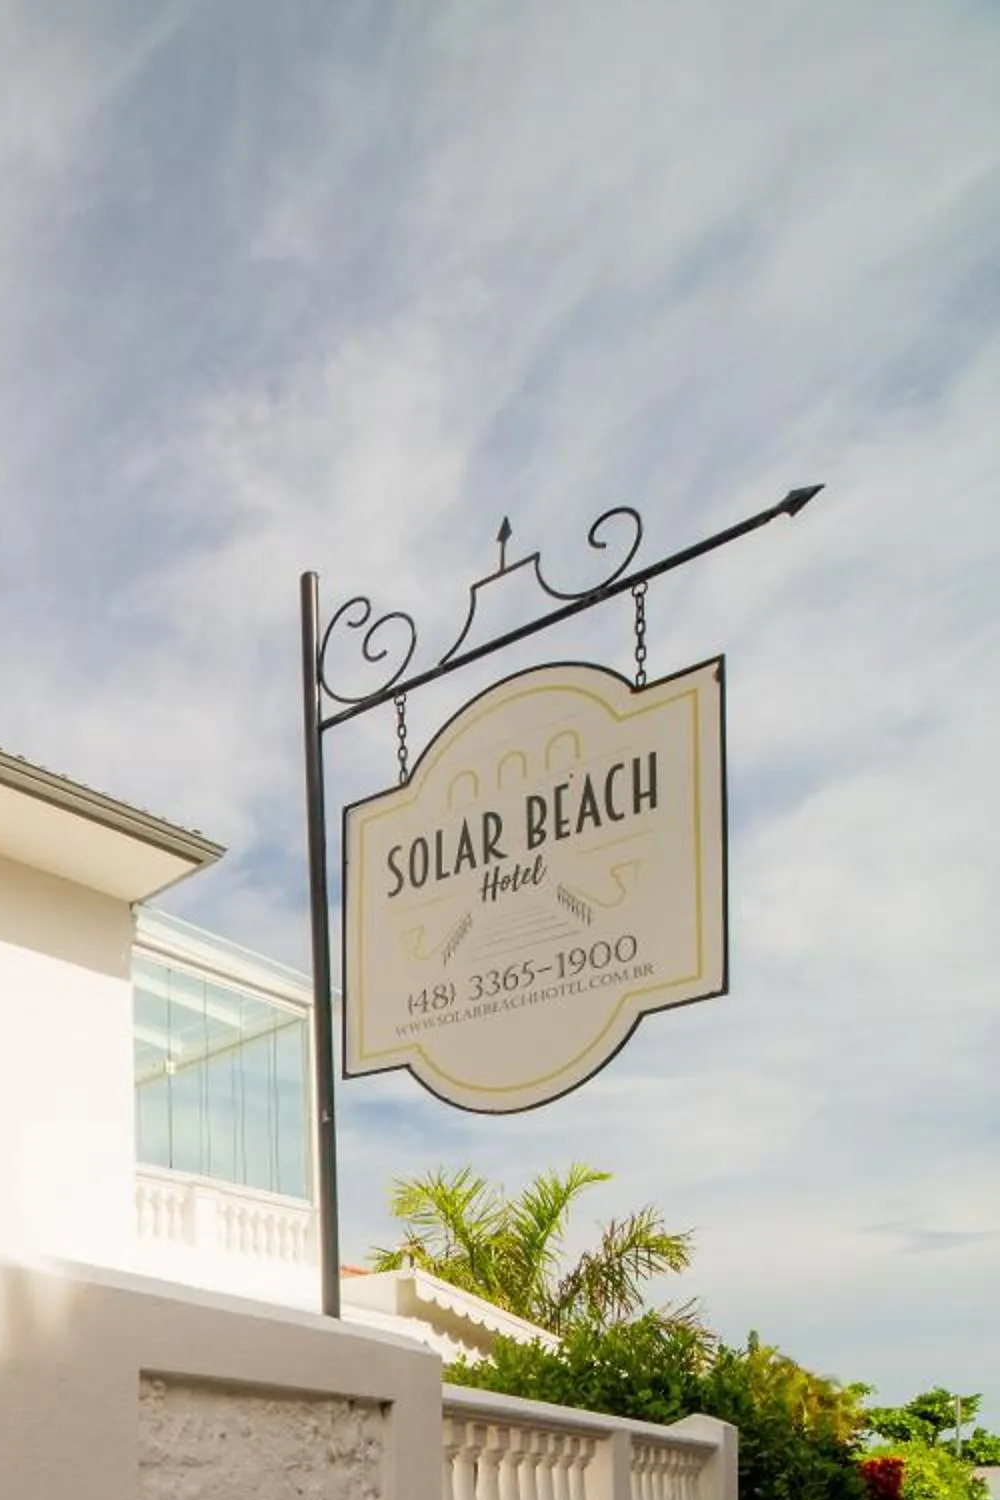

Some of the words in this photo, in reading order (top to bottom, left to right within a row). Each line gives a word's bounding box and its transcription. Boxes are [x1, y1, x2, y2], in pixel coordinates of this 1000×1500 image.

[386, 811, 507, 897] SOLAR
[526, 751, 658, 850] BEACH
[479, 854, 548, 903] Hotel
[394, 962, 655, 1037] WWW.SOLARBEACHHOTEL.COM.BR
[407, 983, 456, 1016] (48)
[468, 934, 638, 1001] 3365-1900
